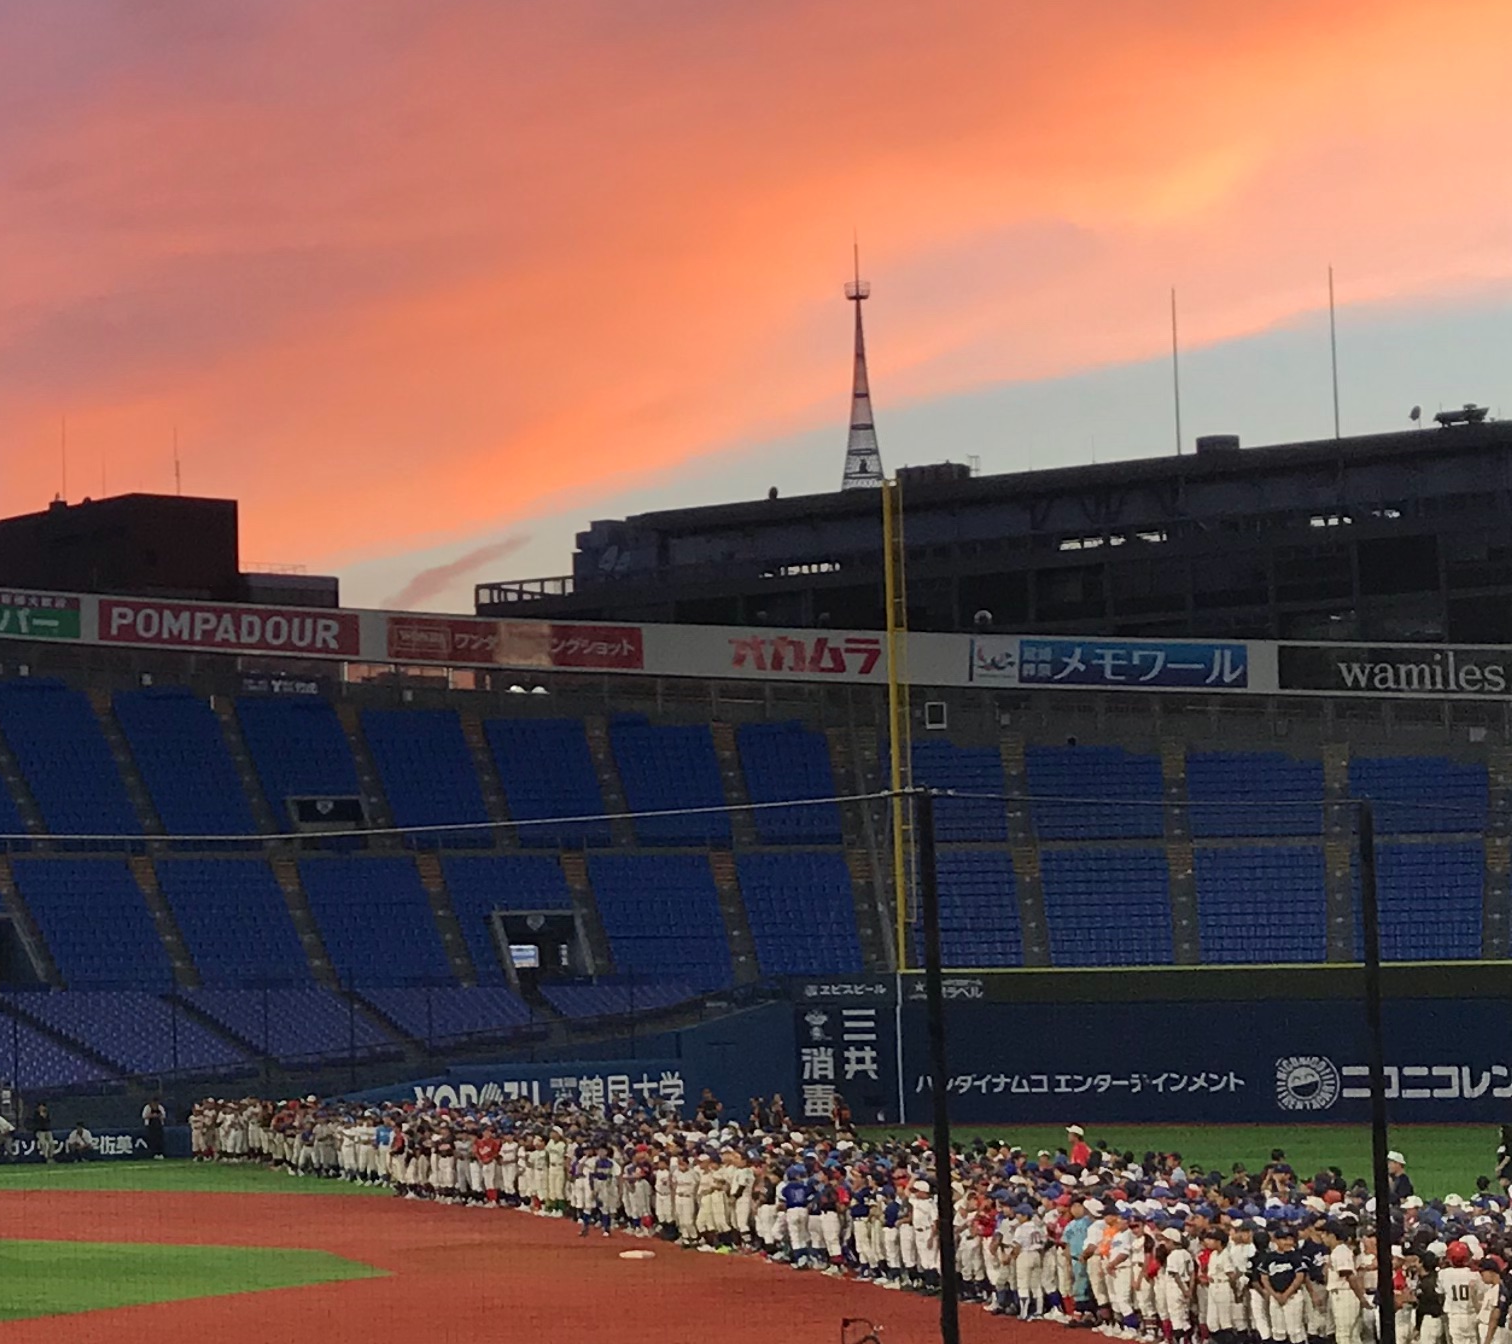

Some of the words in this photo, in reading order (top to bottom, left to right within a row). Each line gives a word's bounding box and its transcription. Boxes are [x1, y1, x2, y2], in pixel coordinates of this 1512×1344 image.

[109, 606, 340, 650] POMPADOUR
[727, 636, 882, 675] オカムラ
[1053, 647, 1245, 685] メモワール
[1337, 653, 1506, 693] wamiles
[916, 1074, 1049, 1094] バダイナムコ
[1450, 1284, 1470, 1303] 10
